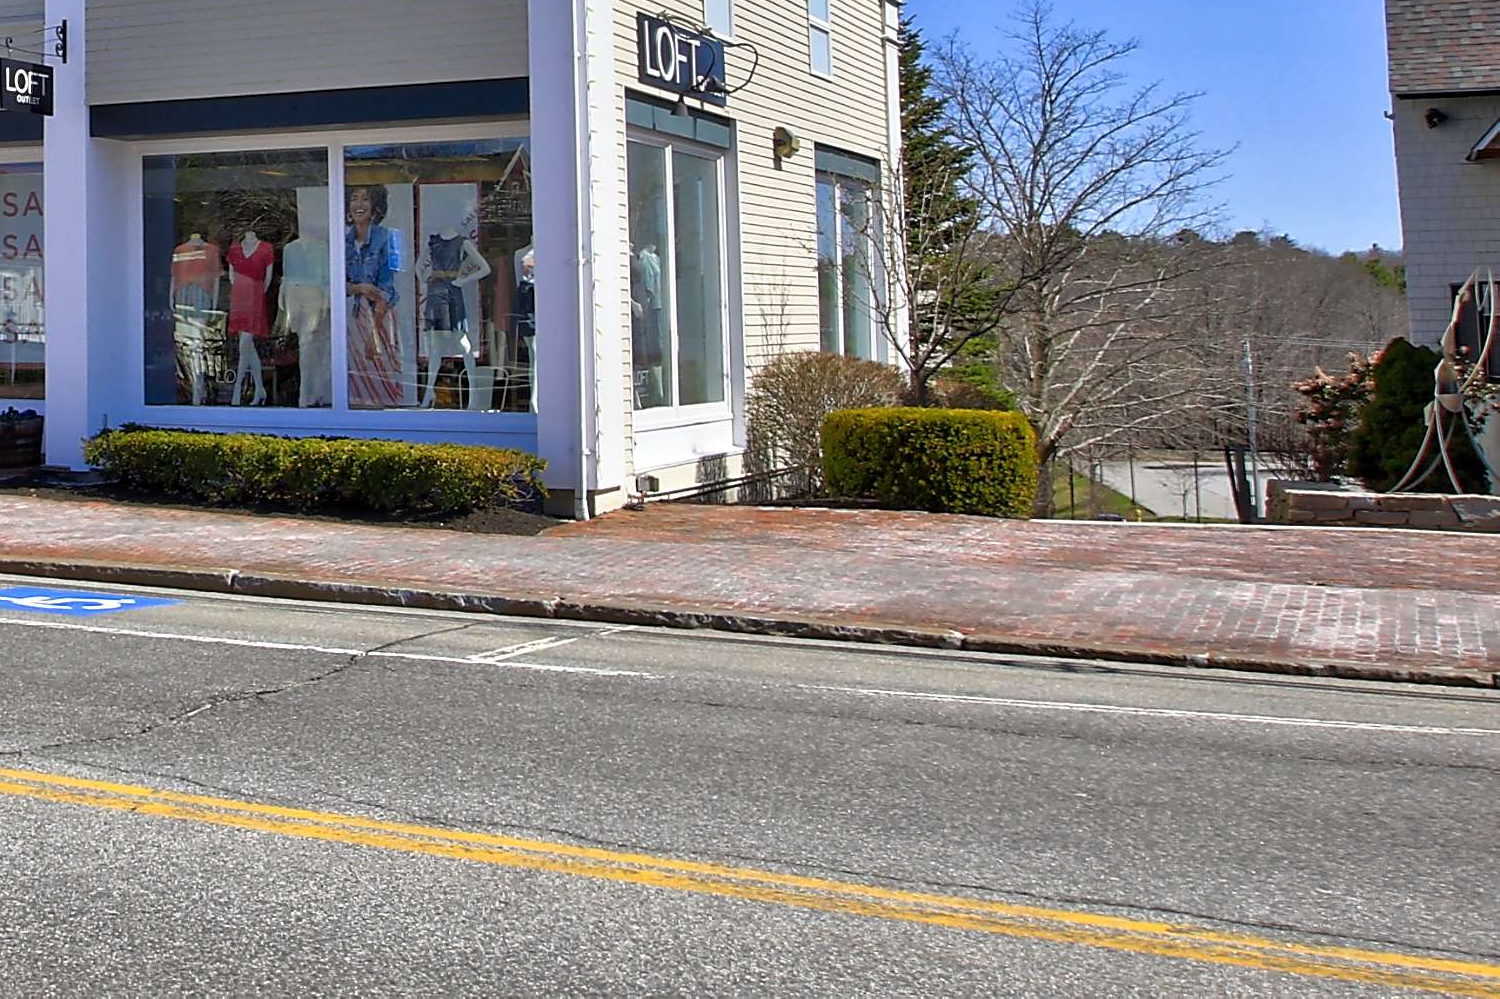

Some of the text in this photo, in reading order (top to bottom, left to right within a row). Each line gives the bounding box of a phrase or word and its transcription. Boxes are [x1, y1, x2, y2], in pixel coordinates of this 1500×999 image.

[644, 20, 700, 88] LOFT
[5, 66, 49, 97] LOFT
[16, 94, 40, 105] OUTLET
